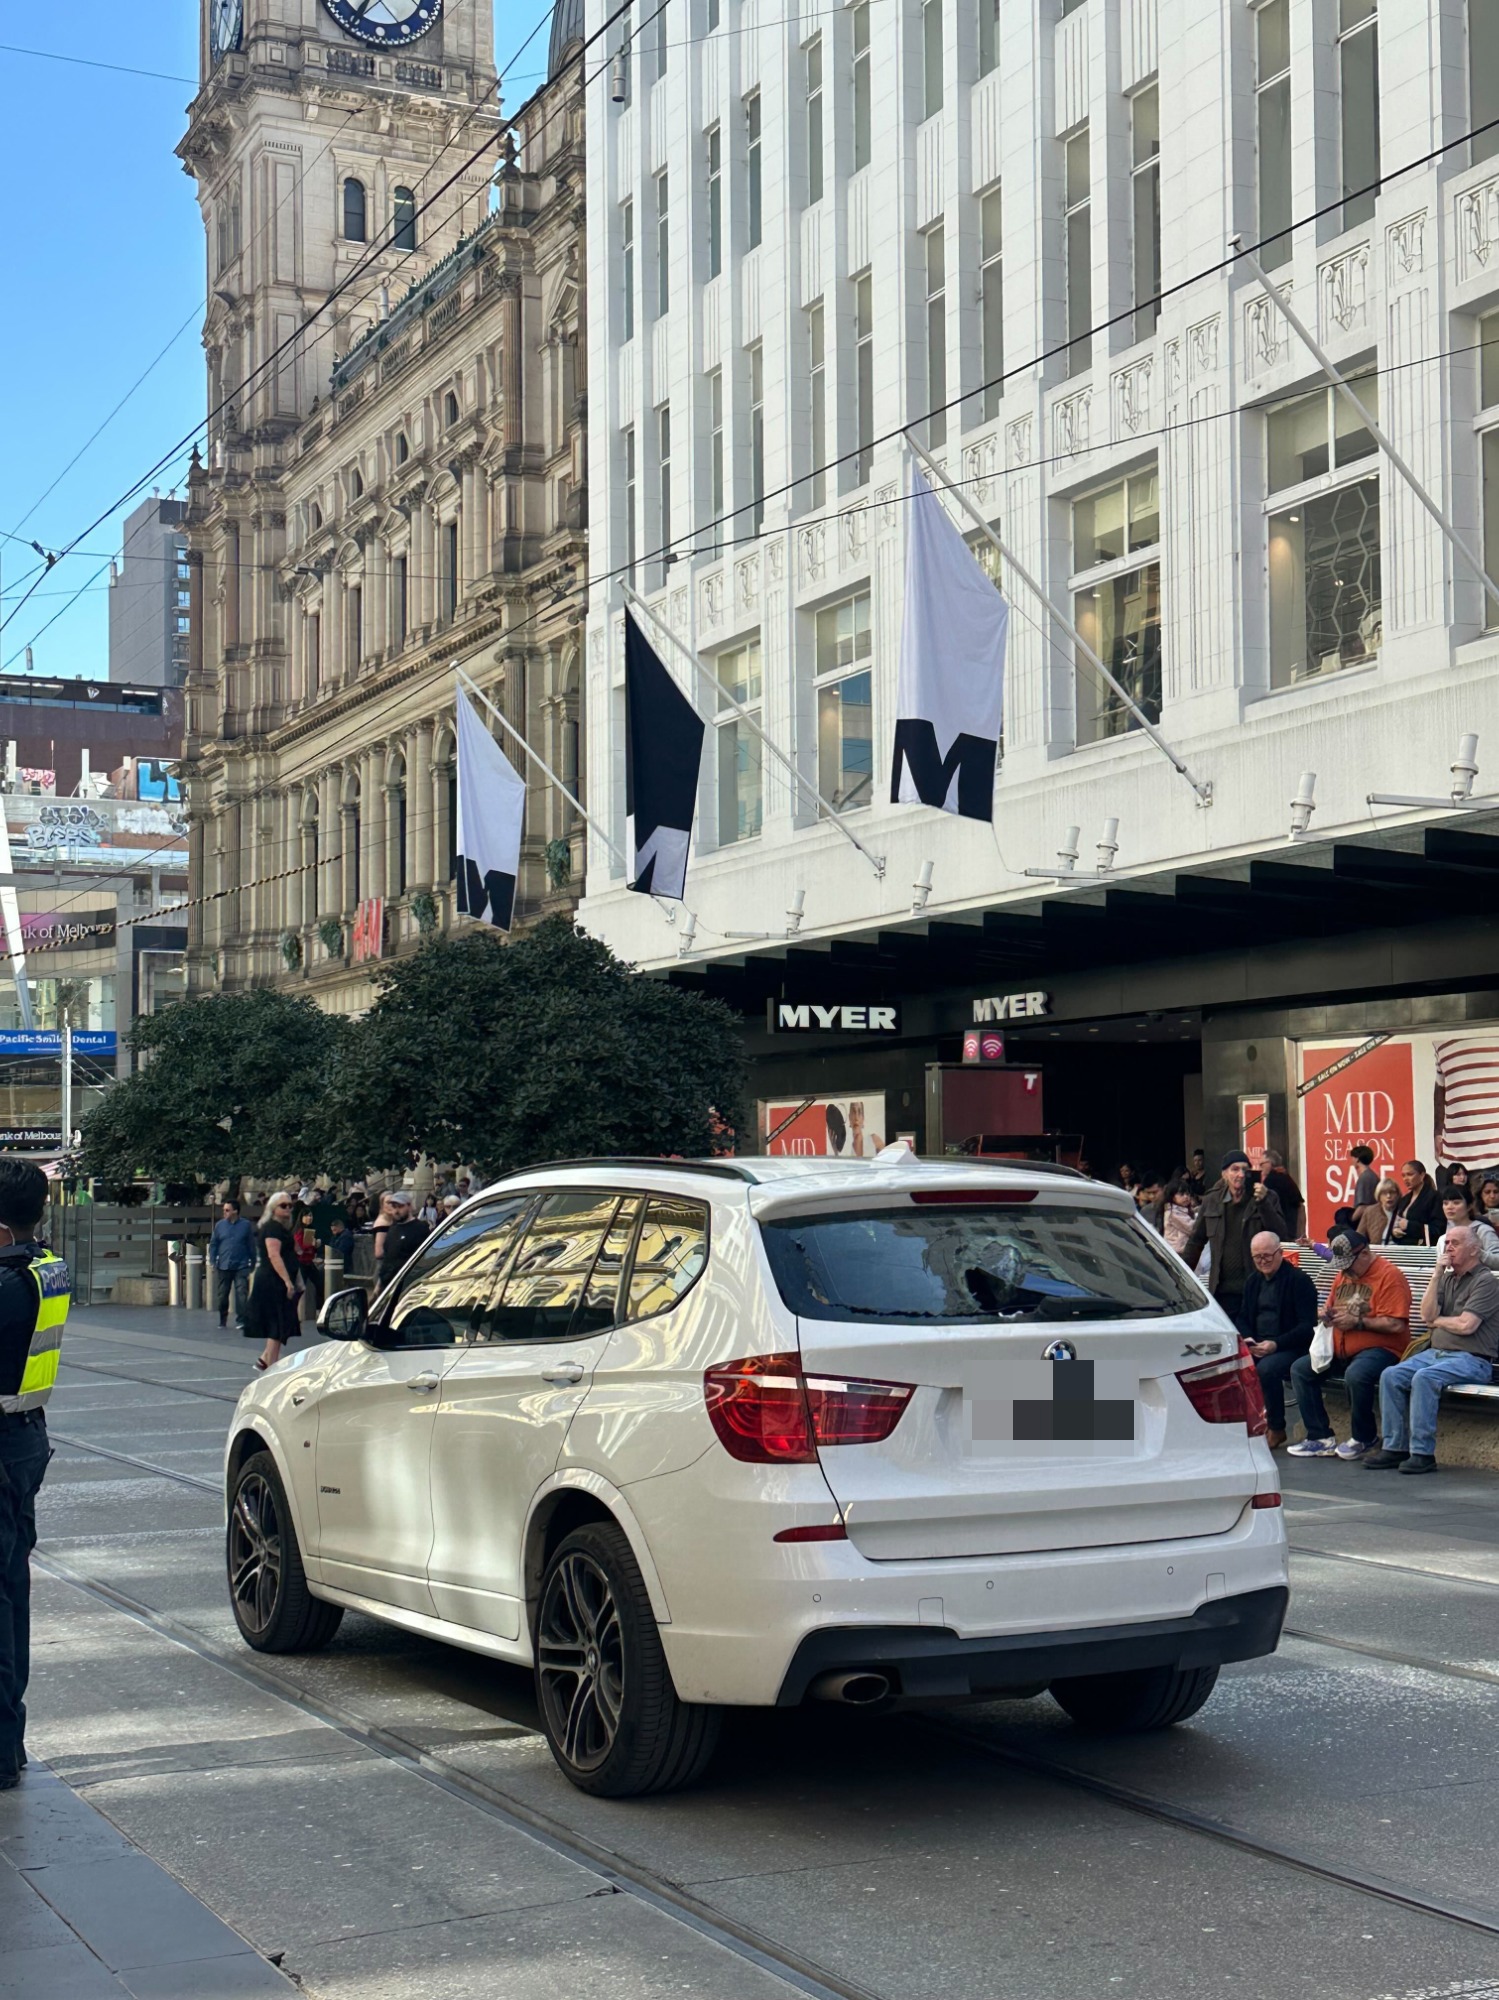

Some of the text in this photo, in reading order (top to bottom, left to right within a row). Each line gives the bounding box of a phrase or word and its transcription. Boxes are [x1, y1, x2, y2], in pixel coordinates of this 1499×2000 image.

[40, 924, 54, 939] of
[779, 1004, 897, 1030] MYER
[973, 991, 1048, 1022] MYER
[0, 1034, 34, 1043] Pacific
[72, 1035, 107, 1044] Dental
[1023, 1073, 1038, 1090] T
[1323, 1090, 1394, 1135] MID
[1325, 1164, 1395, 1204] SA
[1180, 1343, 1223, 1357] X3
